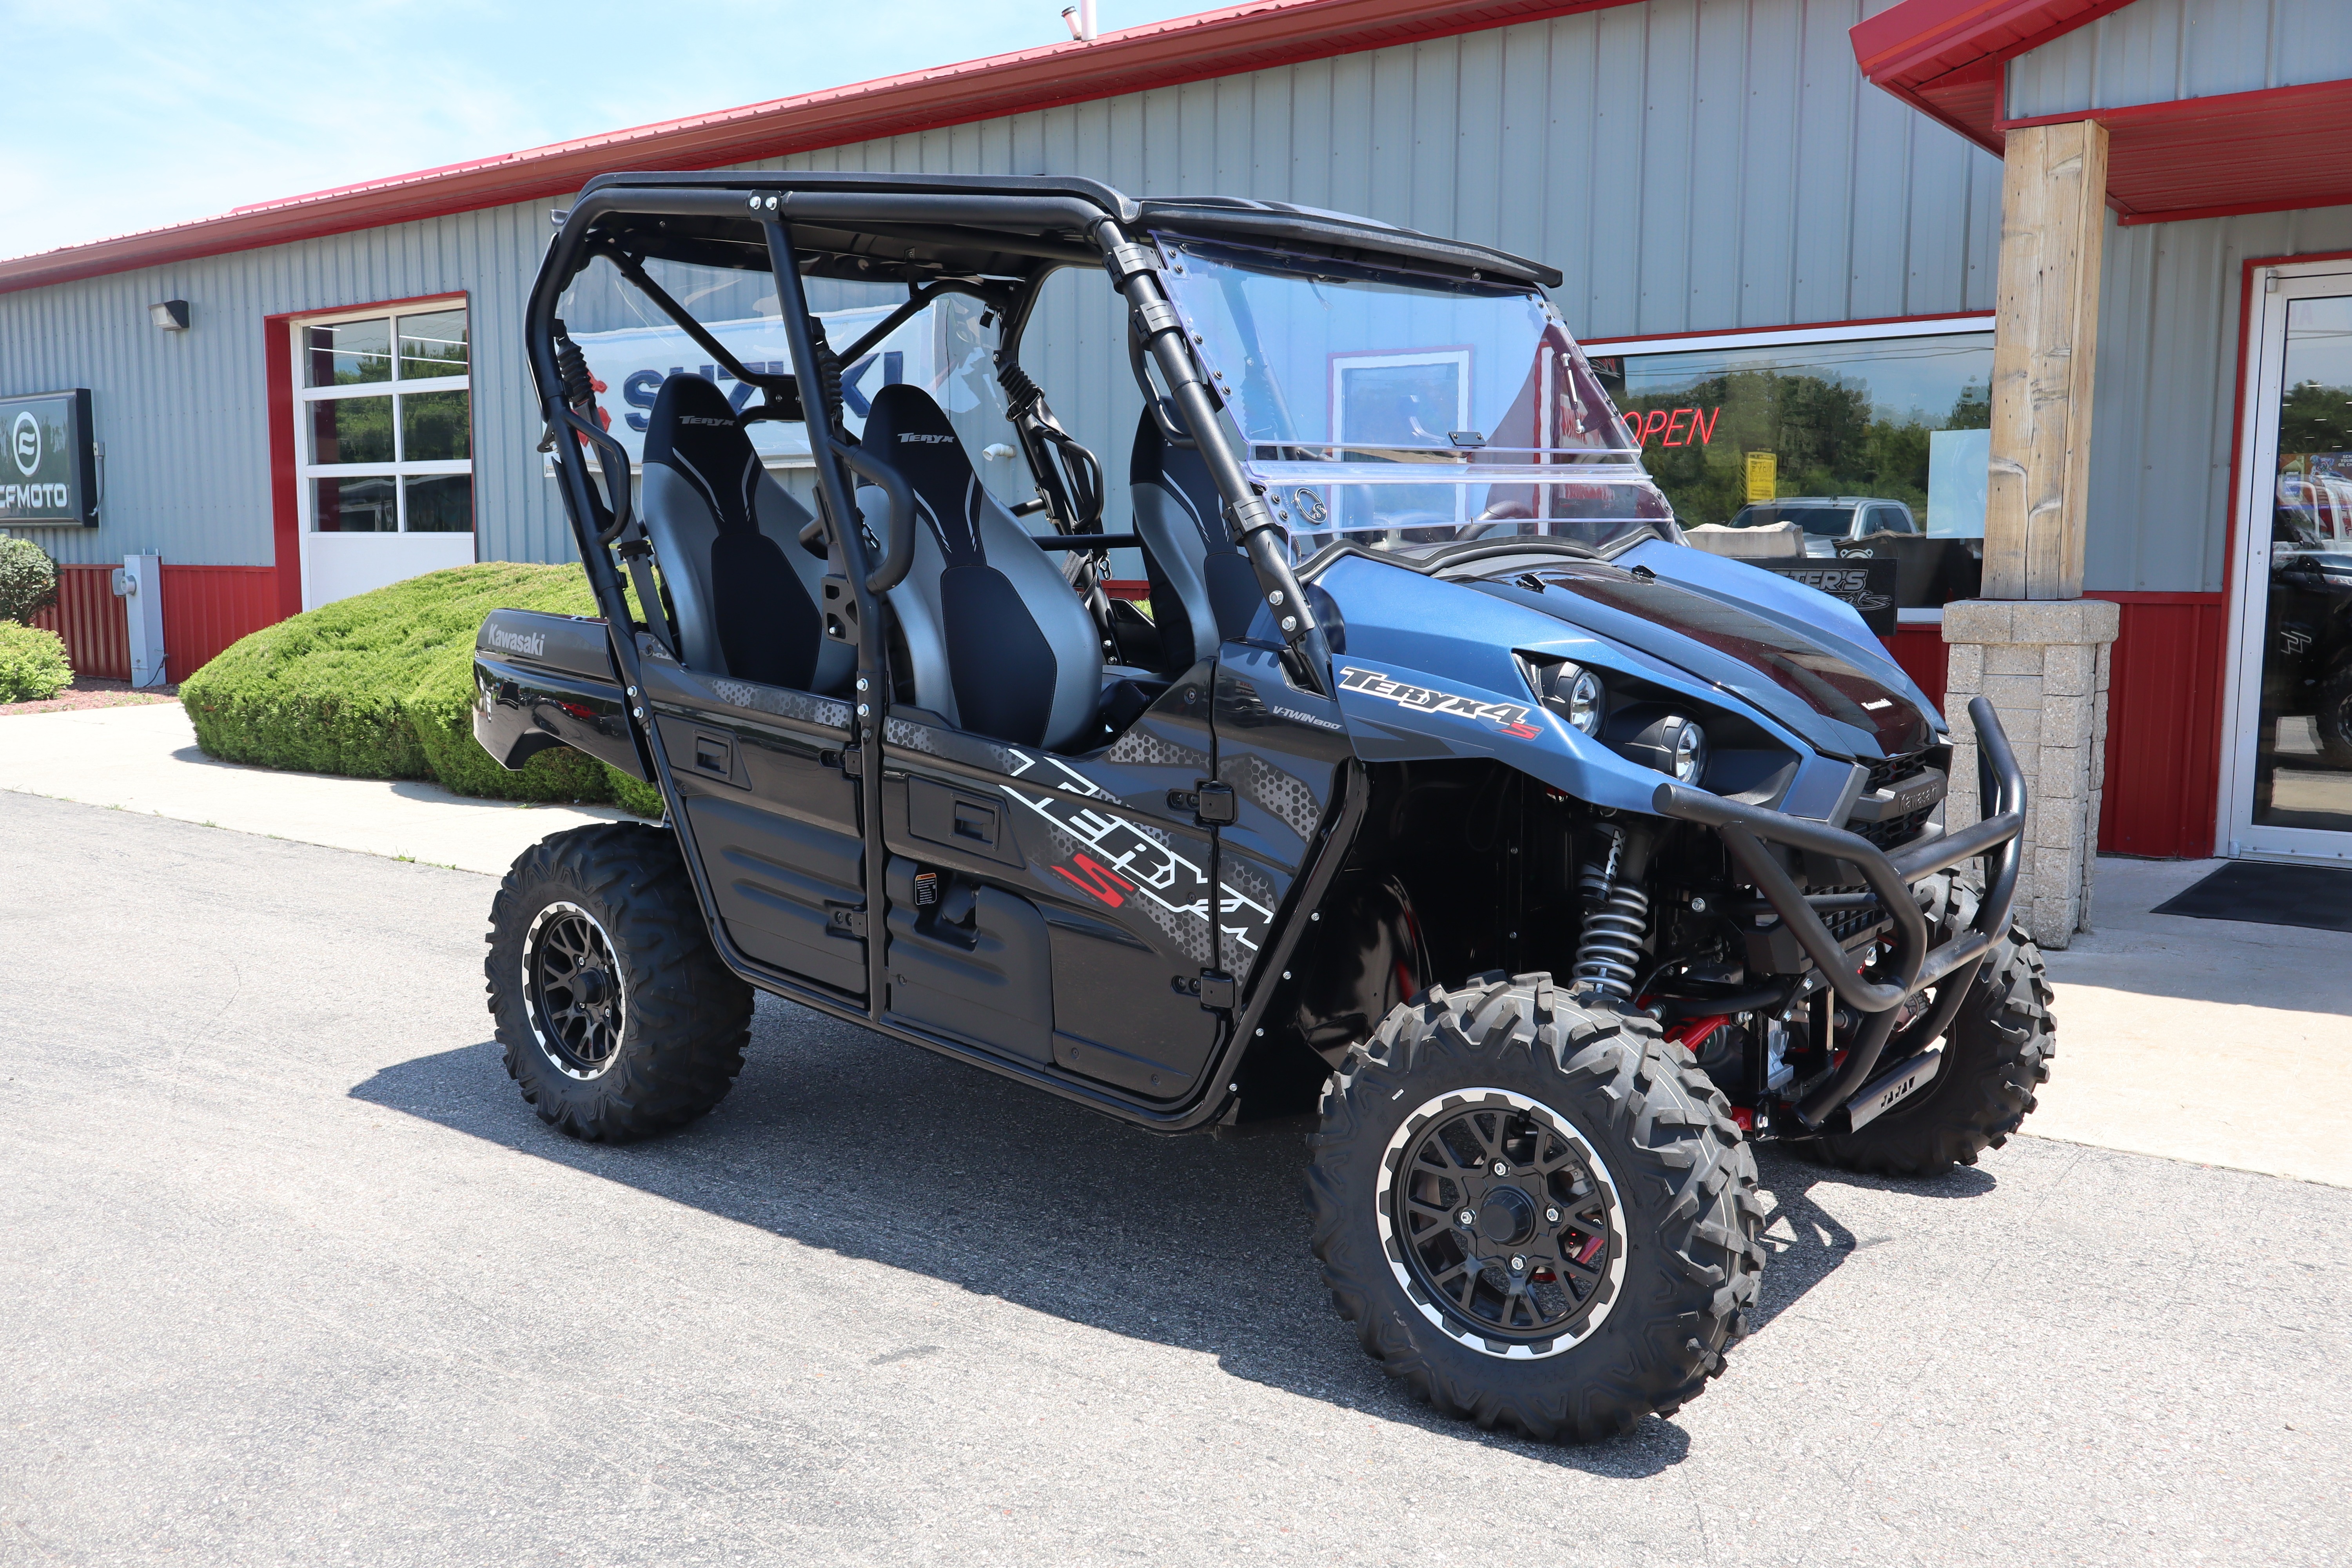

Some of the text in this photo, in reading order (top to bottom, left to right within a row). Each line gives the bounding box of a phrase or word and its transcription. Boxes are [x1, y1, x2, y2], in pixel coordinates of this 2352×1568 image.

[0, 483, 67, 509] CFMOTO
[488, 623, 545, 656] Kawasaki
[1861, 698, 1893, 710] Kawasaki
[1898, 783, 1938, 813] Kawasaki
